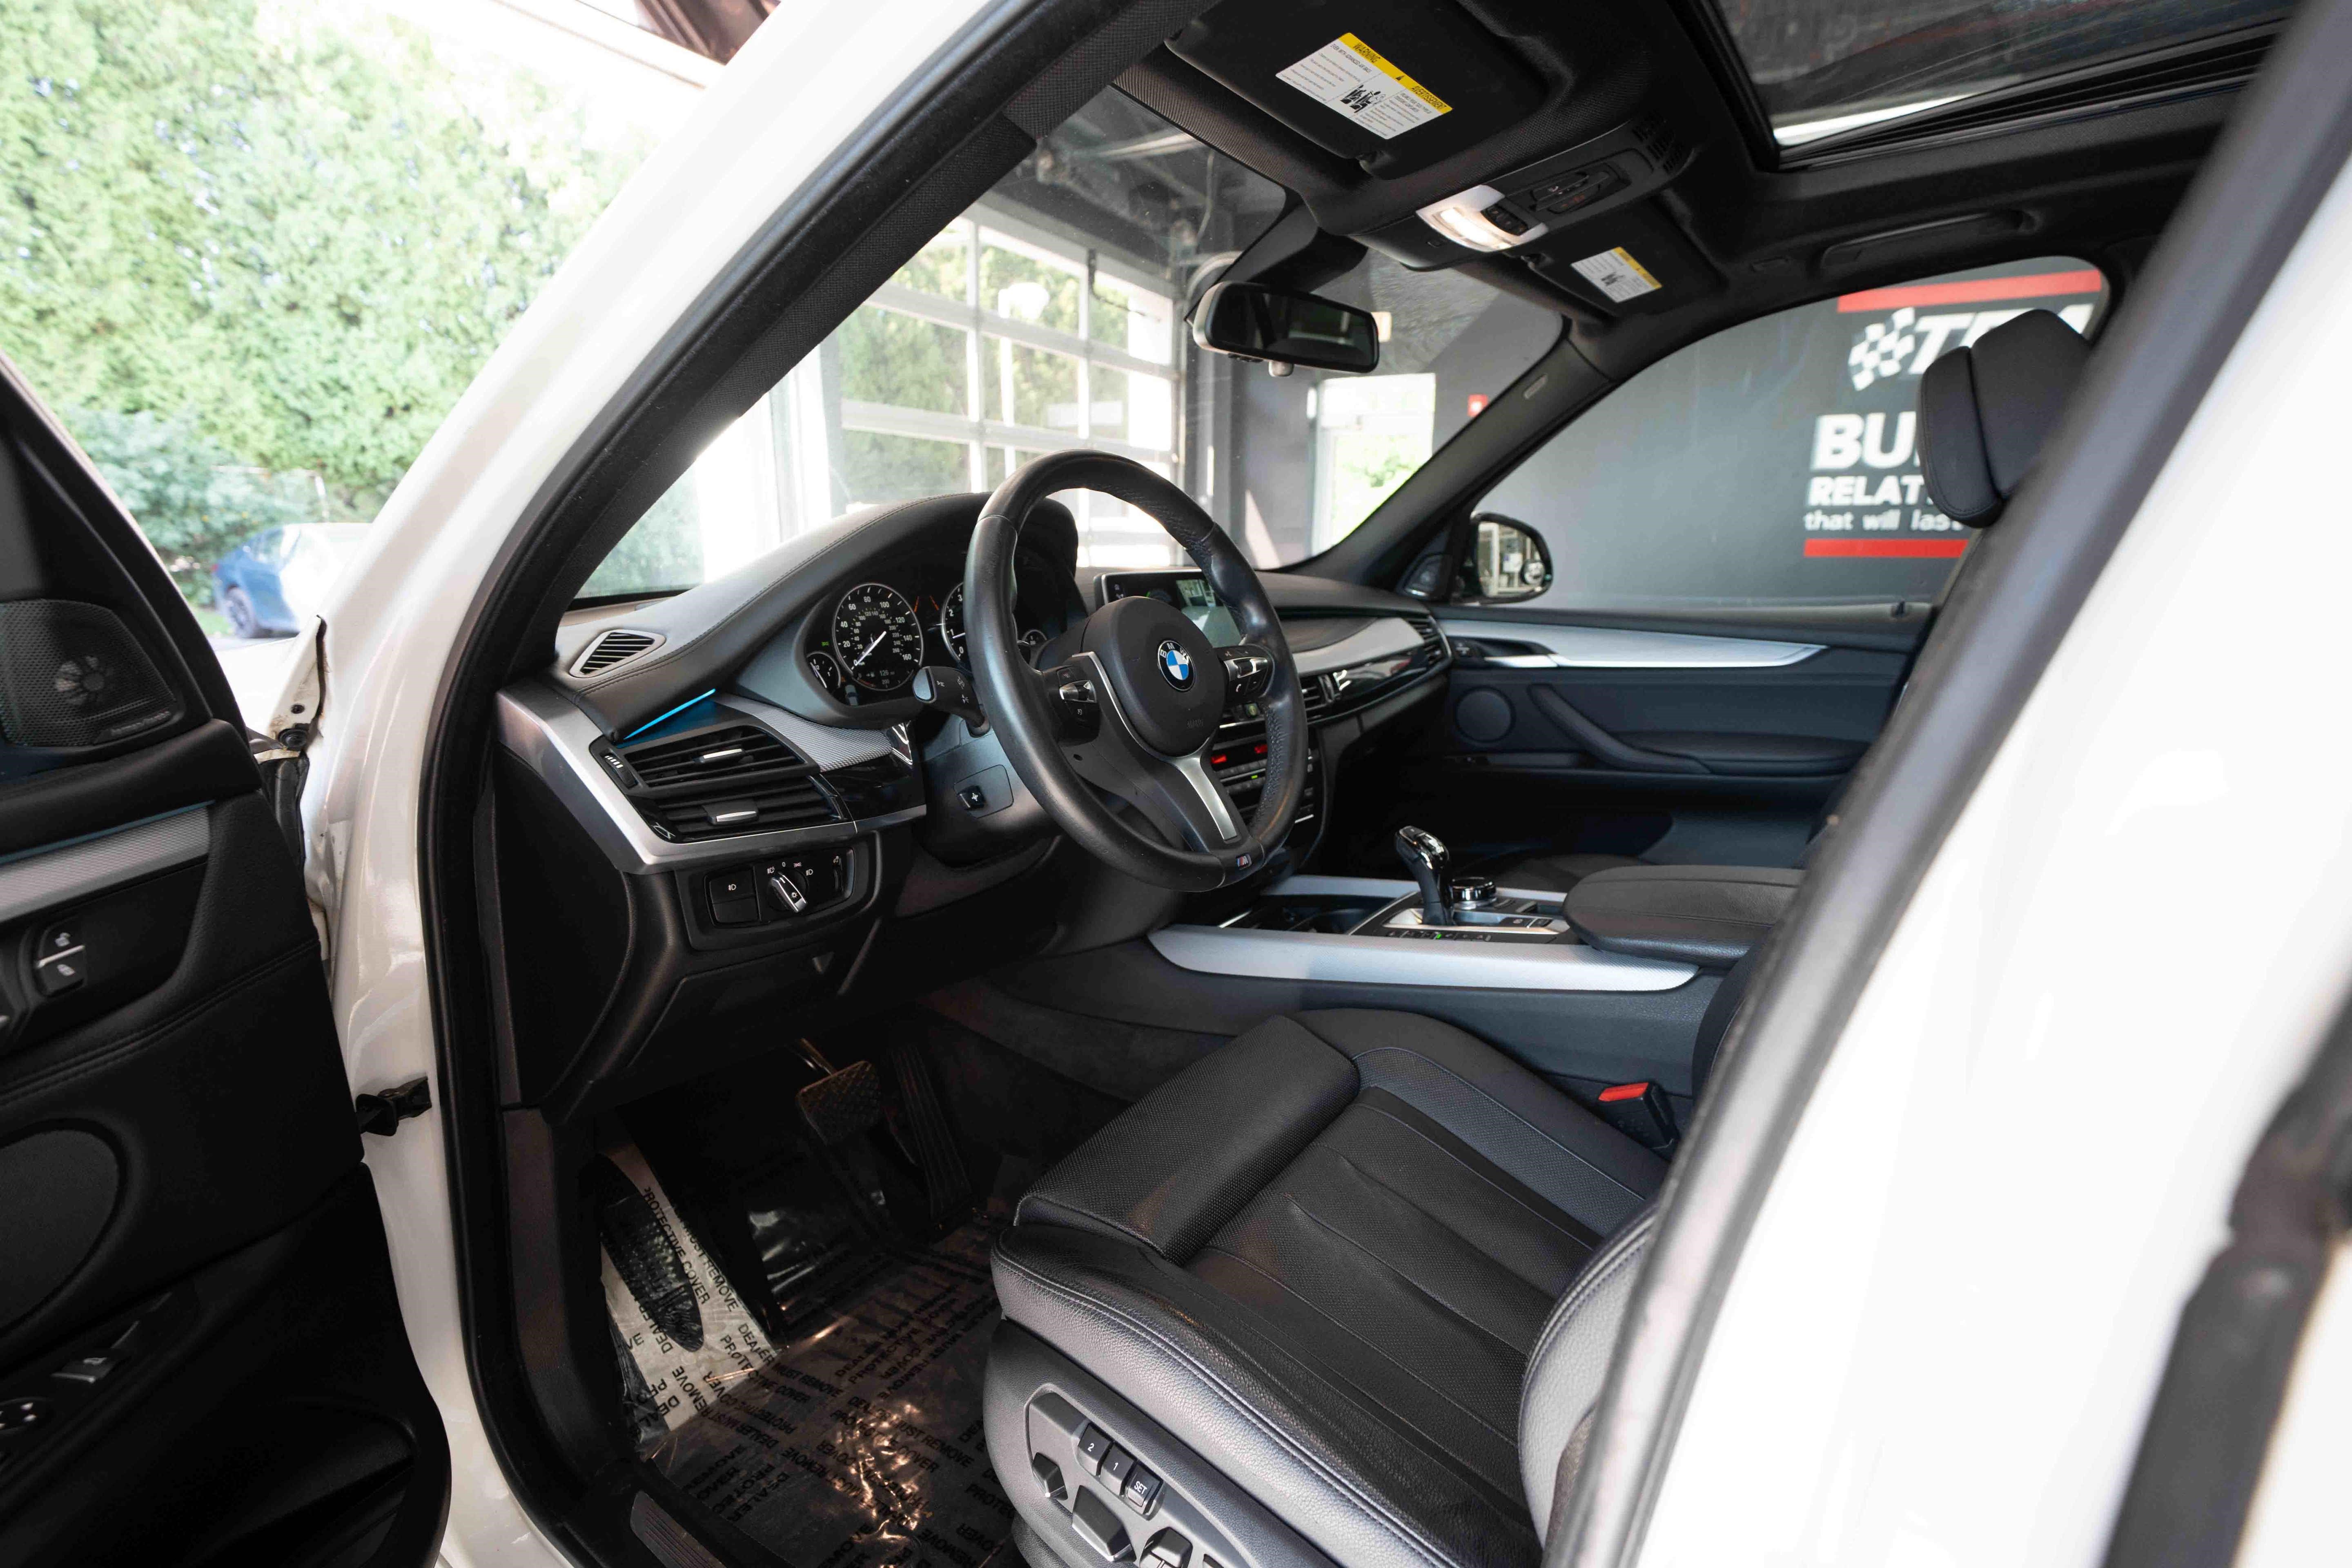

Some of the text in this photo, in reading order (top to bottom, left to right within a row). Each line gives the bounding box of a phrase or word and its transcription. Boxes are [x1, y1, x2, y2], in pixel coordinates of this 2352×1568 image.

[1353, 42, 1381, 63] WARNING
[1811, 411, 1920, 470] BU
[1808, 475, 1934, 506] RELAT
[1804, 509, 1854, 531] that
[1862, 509, 1902, 531] will
[1160, 642, 1189, 664] BMW
[682, 1261, 710, 1305] COVER
[704, 1258, 739, 1312] REMOVE
[738, 1323, 775, 1366] DEALER
[672, 1365, 710, 1418] REMOVE
[703, 1370, 737, 1405] COVER
[816, 1439, 858, 1467] COVER
[898, 1444, 940, 1473] COVER
[923, 1434, 975, 1468] REMOVE
[1087, 1443, 1095, 1452] 2
[1113, 1462, 1119, 1471] 1
[1134, 1481, 1147, 1495] SET
